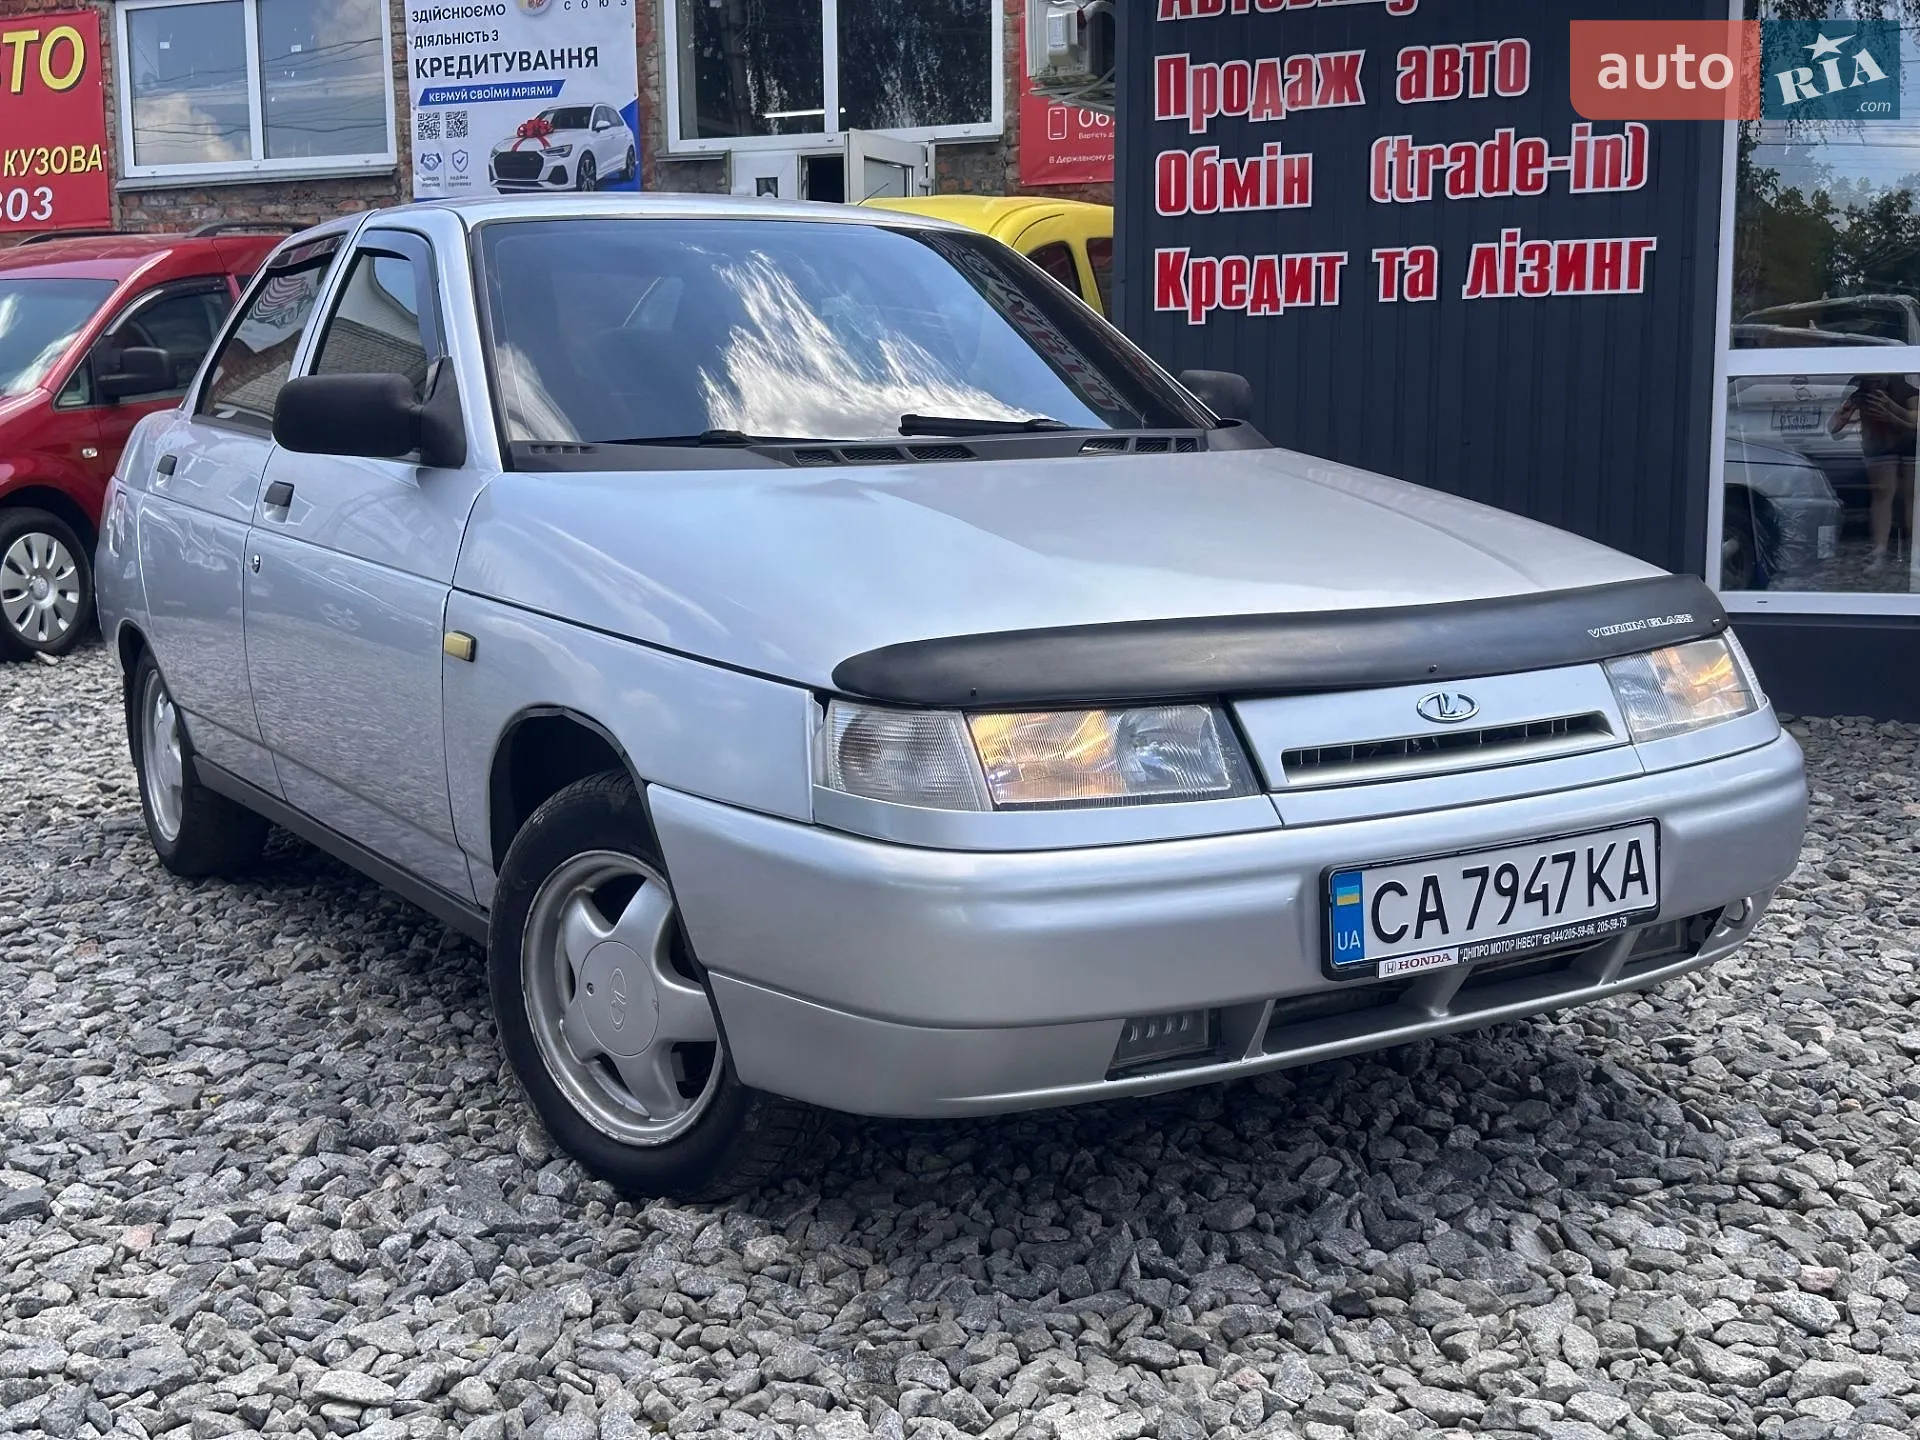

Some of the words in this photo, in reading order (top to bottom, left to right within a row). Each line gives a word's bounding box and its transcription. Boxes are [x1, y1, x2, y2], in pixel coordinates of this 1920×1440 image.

[412, 4, 506, 23] ЗДІЙСНЮЄМО
[414, 31, 490, 49] ДІЯЛЬНІСТЬ
[415, 46, 599, 79] КРЕДИТУВАННЯ
[429, 89, 468, 103] КЕРМУЙ
[469, 86, 509, 100] СВОЇМИ
[511, 85, 553, 98] МРІЯМИ
[1154, 49, 1366, 134] Продаж
[1396, 38, 1531, 104] авто
[3, 144, 103, 177] КУЗОВА
[1154, 141, 1313, 217] Обмін
[1369, 121, 1649, 203] (trade-in)
[0, 186, 53, 222] 03
[1154, 246, 1348, 325] Кредит
[1372, 246, 1438, 303] та
[1462, 228, 1657, 299] лізинг
[1587, 619, 1647, 638] VORON
[1647, 613, 1694, 628] GLASS
[1371, 874, 1450, 944] CA
[1462, 850, 1576, 931] 7947
[1586, 839, 1649, 907] KA
[1337, 929, 1361, 951] UA
[1490, 939, 1516, 955] МОТОР
[1398, 952, 1452, 971] HONDA
